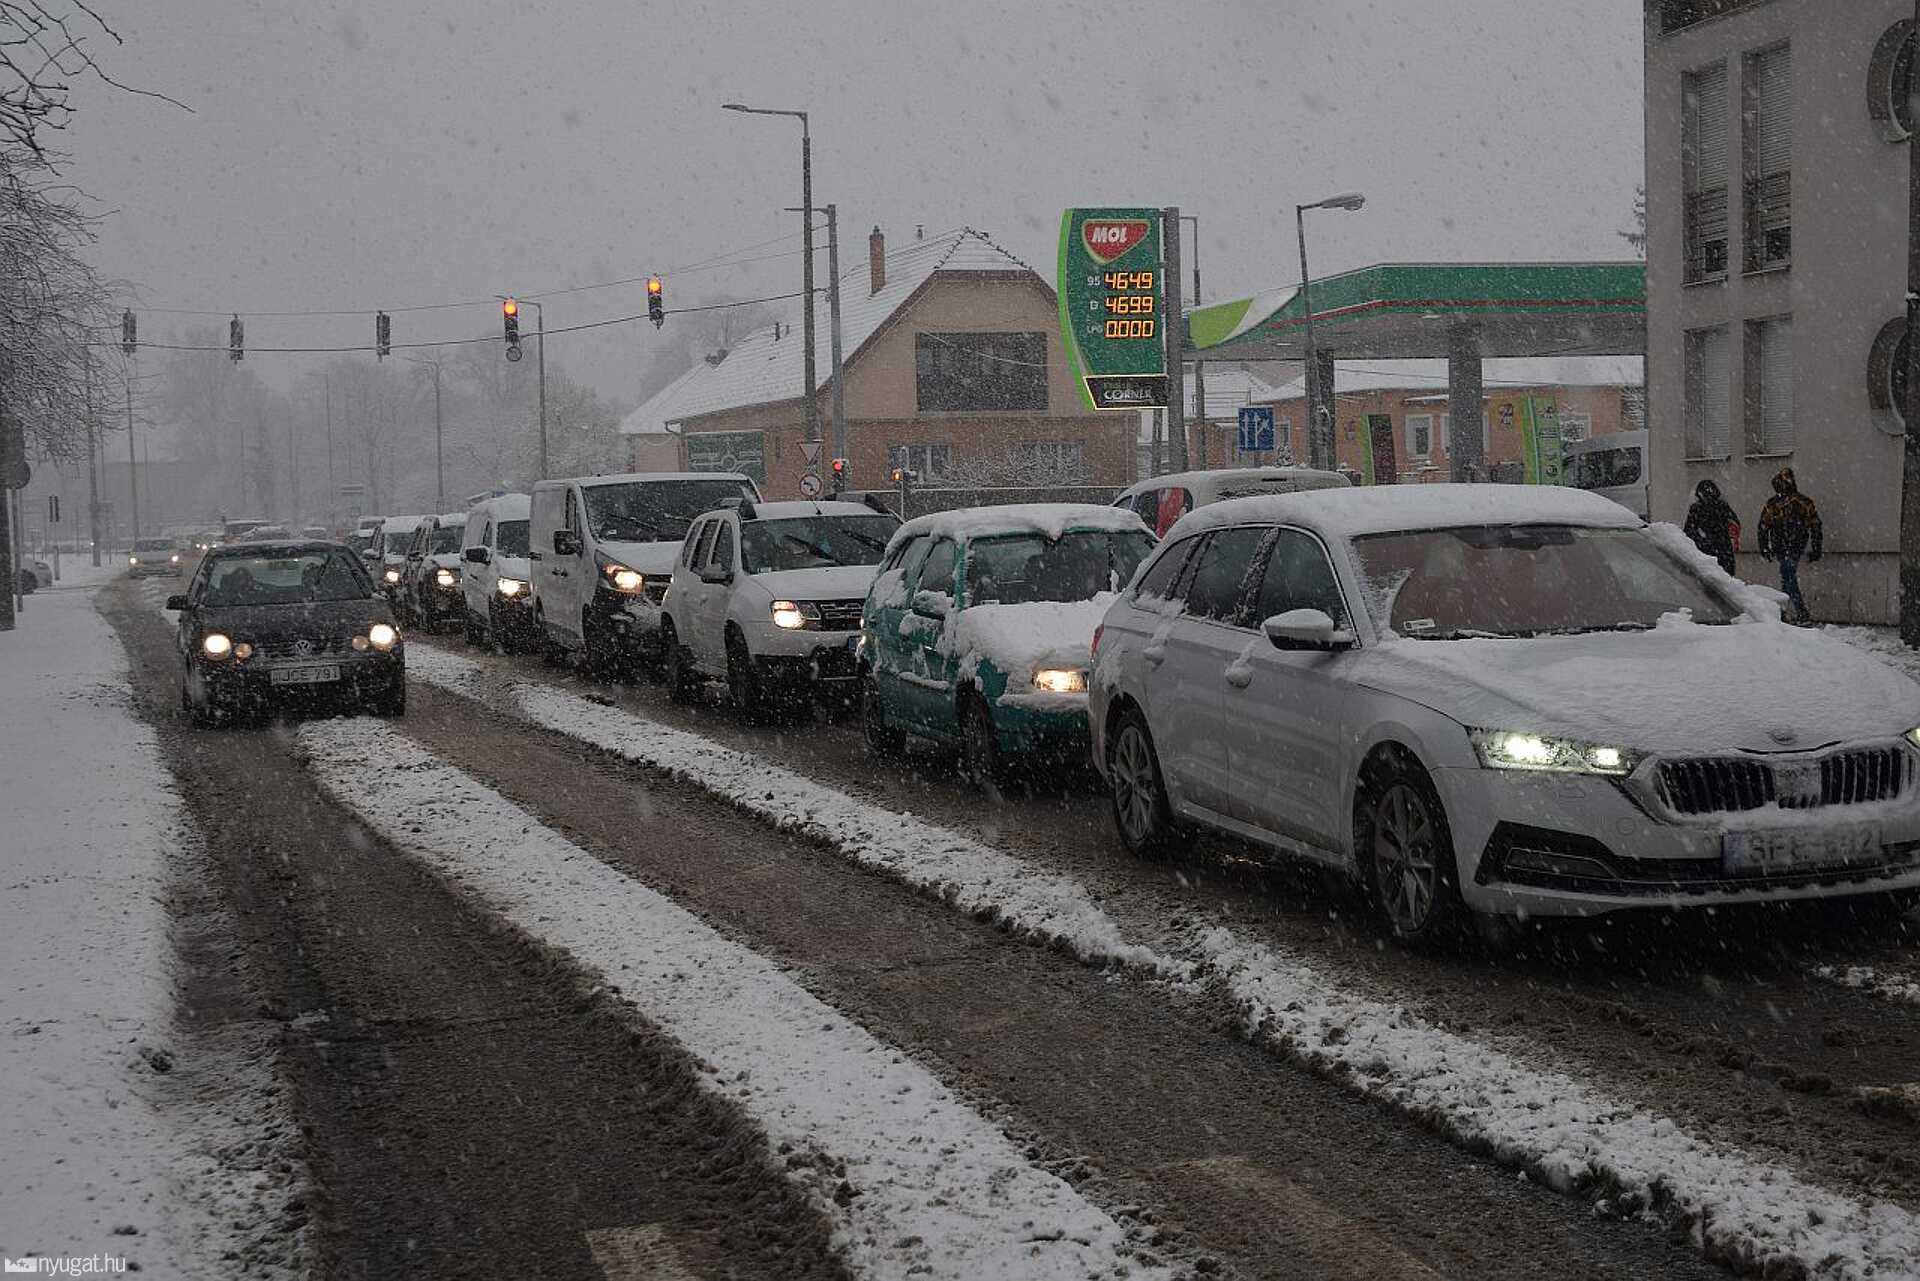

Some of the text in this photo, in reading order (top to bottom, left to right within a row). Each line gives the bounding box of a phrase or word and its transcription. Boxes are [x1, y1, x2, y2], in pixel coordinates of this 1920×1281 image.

[1091, 225, 1128, 243] MOL
[1087, 272, 1153, 289] 95 4649
[1104, 296, 1153, 313] 4699
[1104, 320, 1155, 337] 0000
